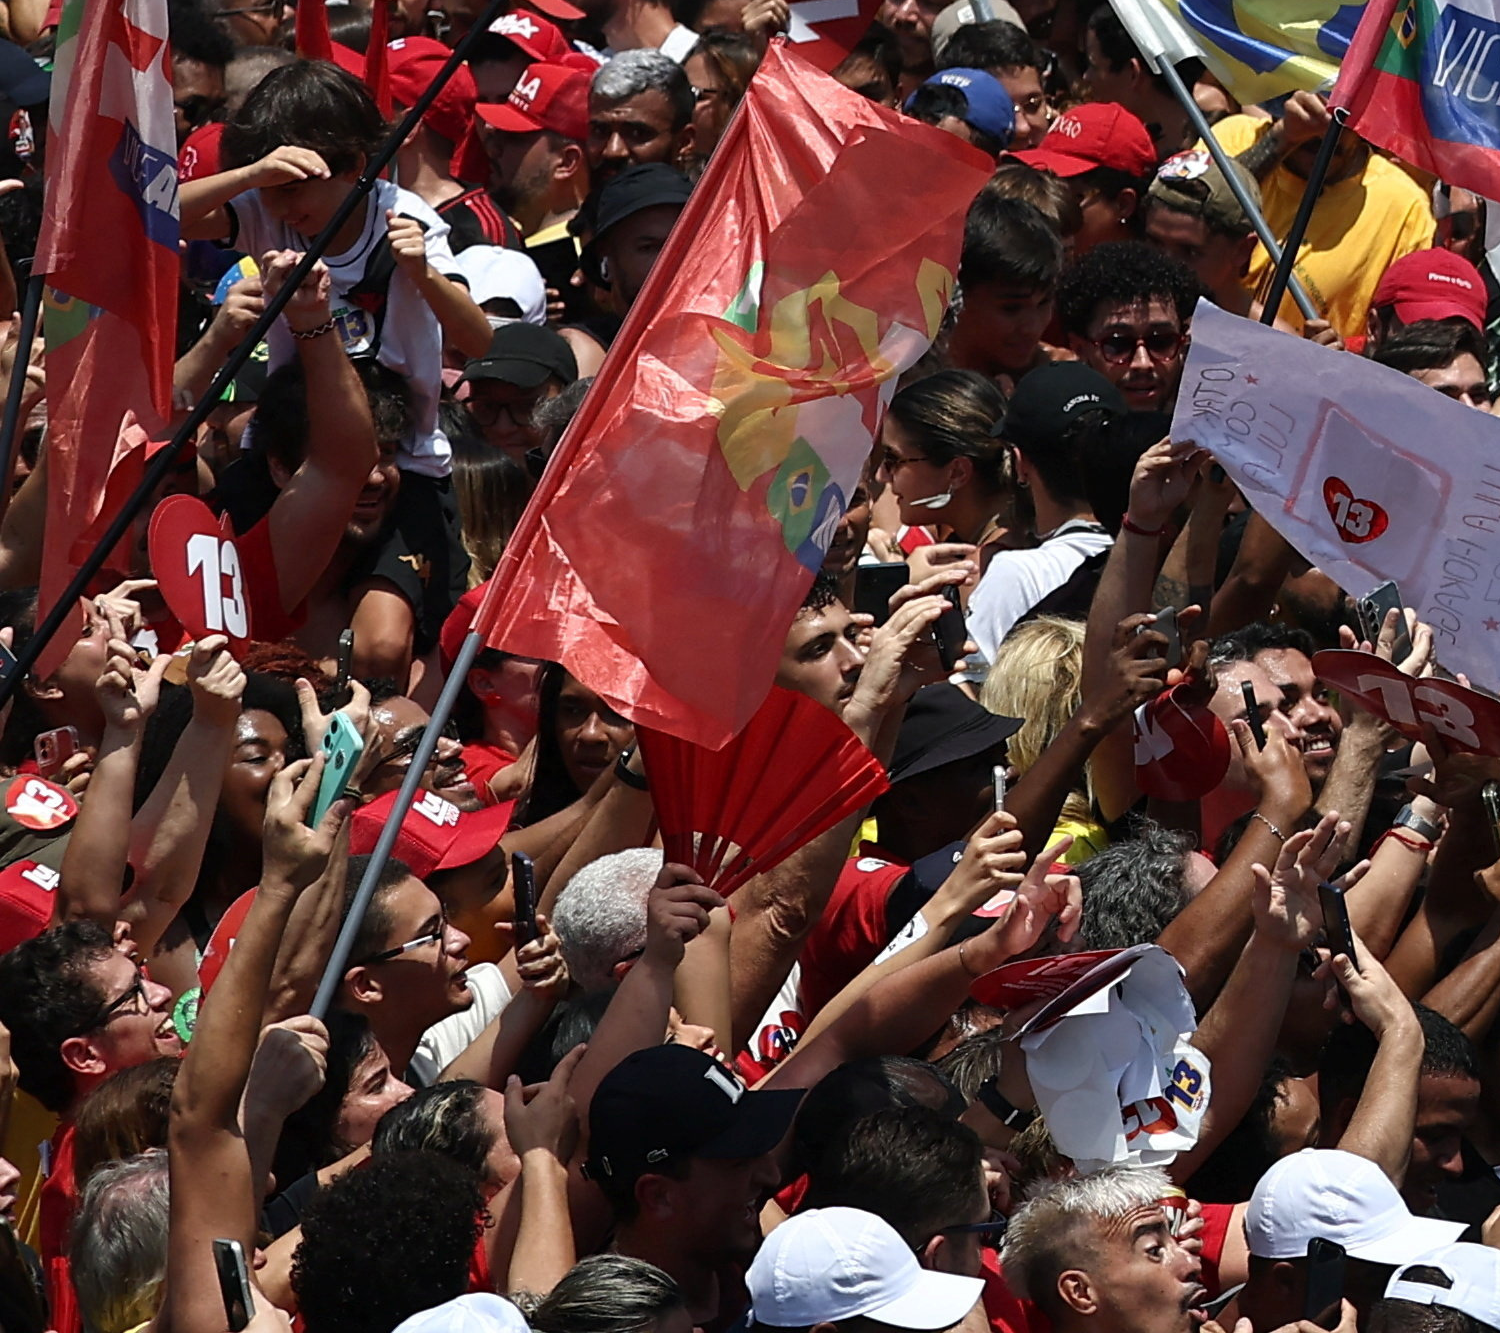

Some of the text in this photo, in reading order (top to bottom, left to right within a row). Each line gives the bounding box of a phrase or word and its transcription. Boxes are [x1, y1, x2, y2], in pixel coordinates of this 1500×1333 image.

[1331, 489, 1372, 538] 13
[186, 532, 248, 639] 13
[1359, 673, 1482, 749] 13
